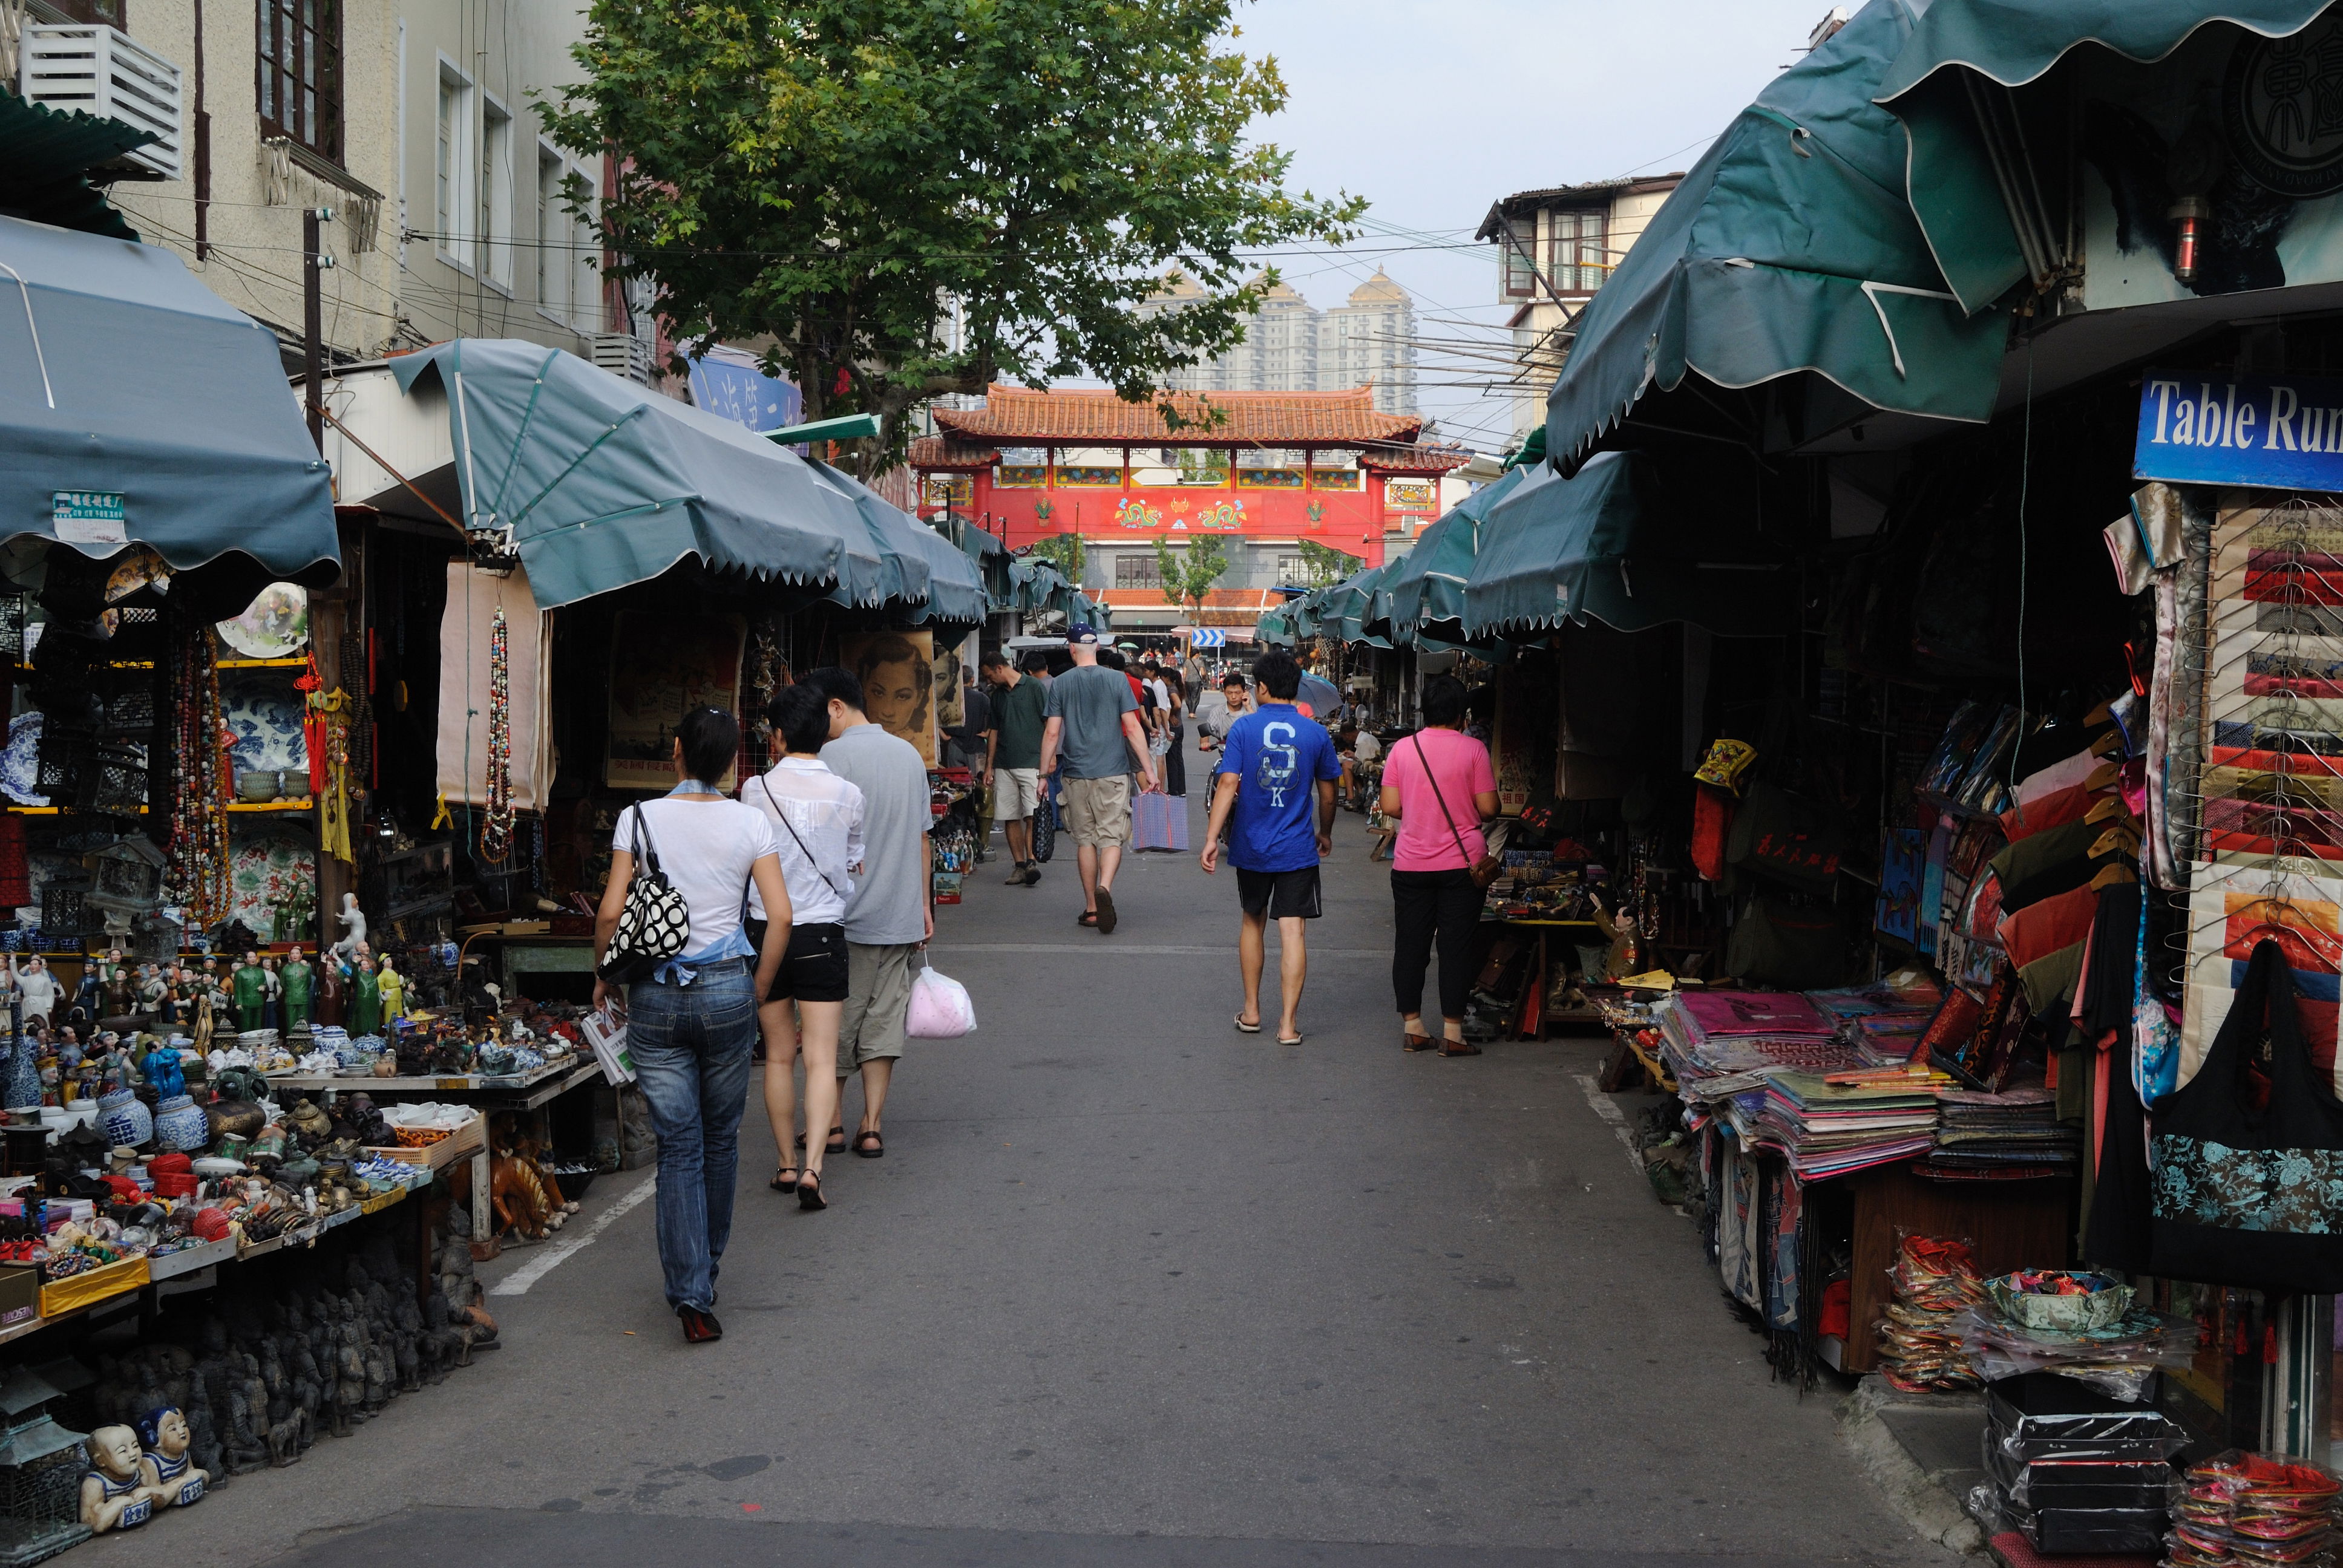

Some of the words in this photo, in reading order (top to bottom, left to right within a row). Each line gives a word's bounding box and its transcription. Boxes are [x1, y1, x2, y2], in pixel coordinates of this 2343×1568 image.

[2150, 380, 2256, 450] Table
[2262, 386, 2343, 454] Run
[1270, 786, 1286, 808] K
